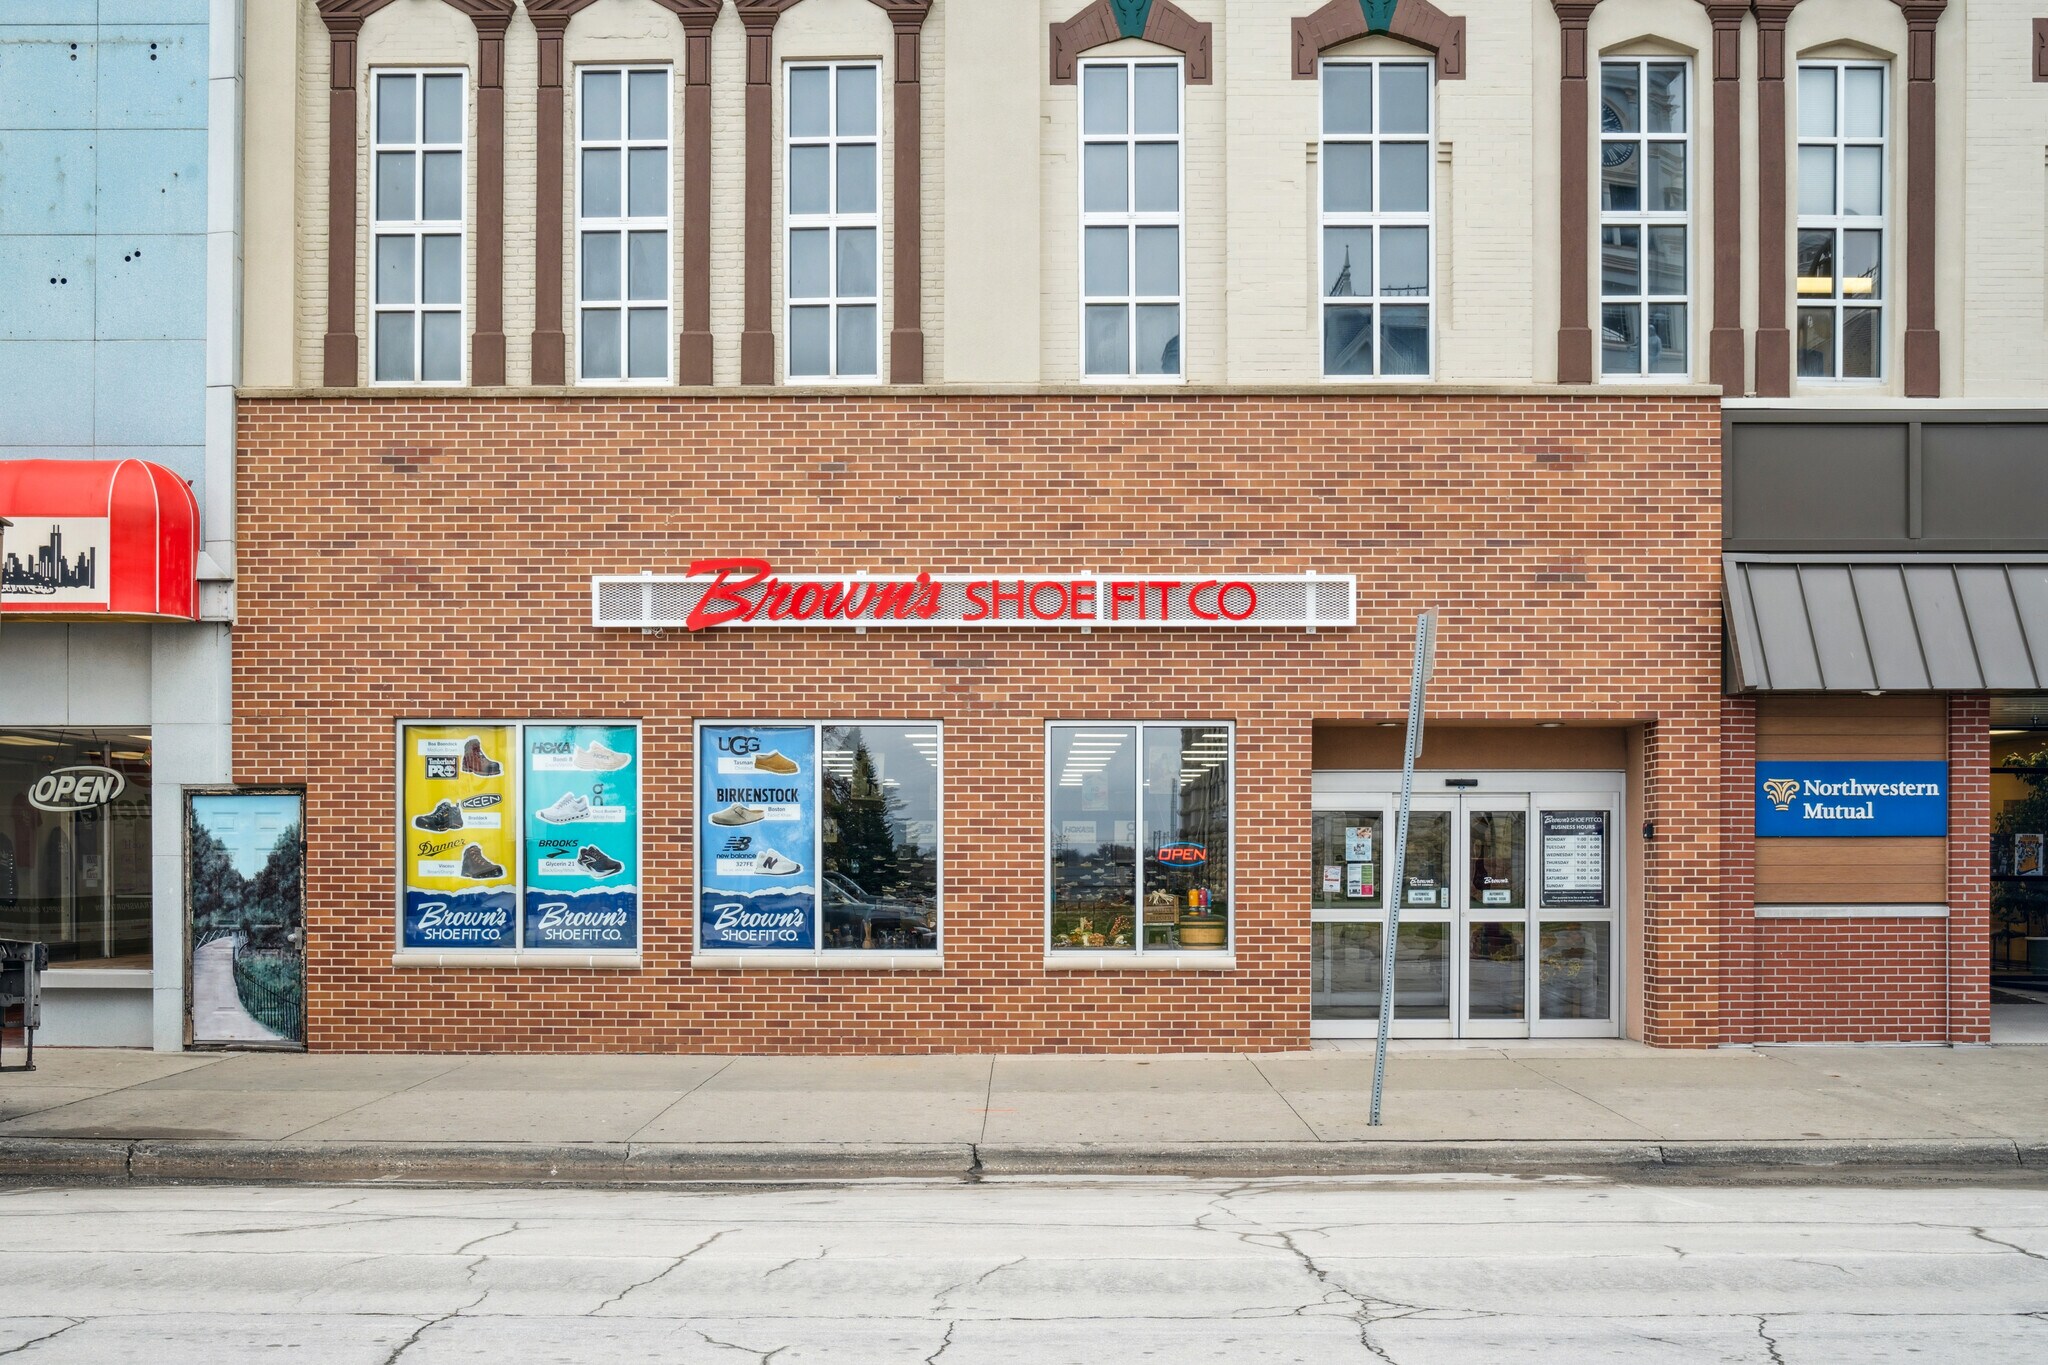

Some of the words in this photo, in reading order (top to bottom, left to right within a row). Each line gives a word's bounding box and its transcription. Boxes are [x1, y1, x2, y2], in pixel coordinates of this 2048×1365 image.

[686, 557, 942, 631] Brown's
[962, 580, 1097, 620] SHOE
[1111, 580, 1181, 620] FIT
[1188, 580, 1257, 620] CO
[531, 742, 572, 754] HOKA
[718, 735, 761, 756] UGG
[428, 757, 456, 765] Timberland
[34, 775, 115, 803] OPEN
[1803, 778, 1940, 796] Northwestern
[463, 796, 500, 807] KEEN
[716, 788, 799, 803] BIRKENSTOCK
[1803, 802, 1875, 819] Mutual
[417, 839, 467, 857] Danner
[538, 839, 579, 848] BROOKS
[1158, 848, 1207, 860] OPEN
[416, 902, 507, 930] Brown's
[537, 902, 627, 930] Brown's
[712, 903, 804, 931] Brown's
[424, 928, 461, 940] SHOE
[462, 928, 481, 940] FIT
[481, 928, 501, 940] CO.
[544, 929, 581, 940] SHOE
[582, 929, 602, 940] FIT
[602, 929, 622, 940] CO.
[720, 930, 758, 941] SHOE
[758, 930, 778, 941] FIT
[778, 930, 799, 941] CO.
